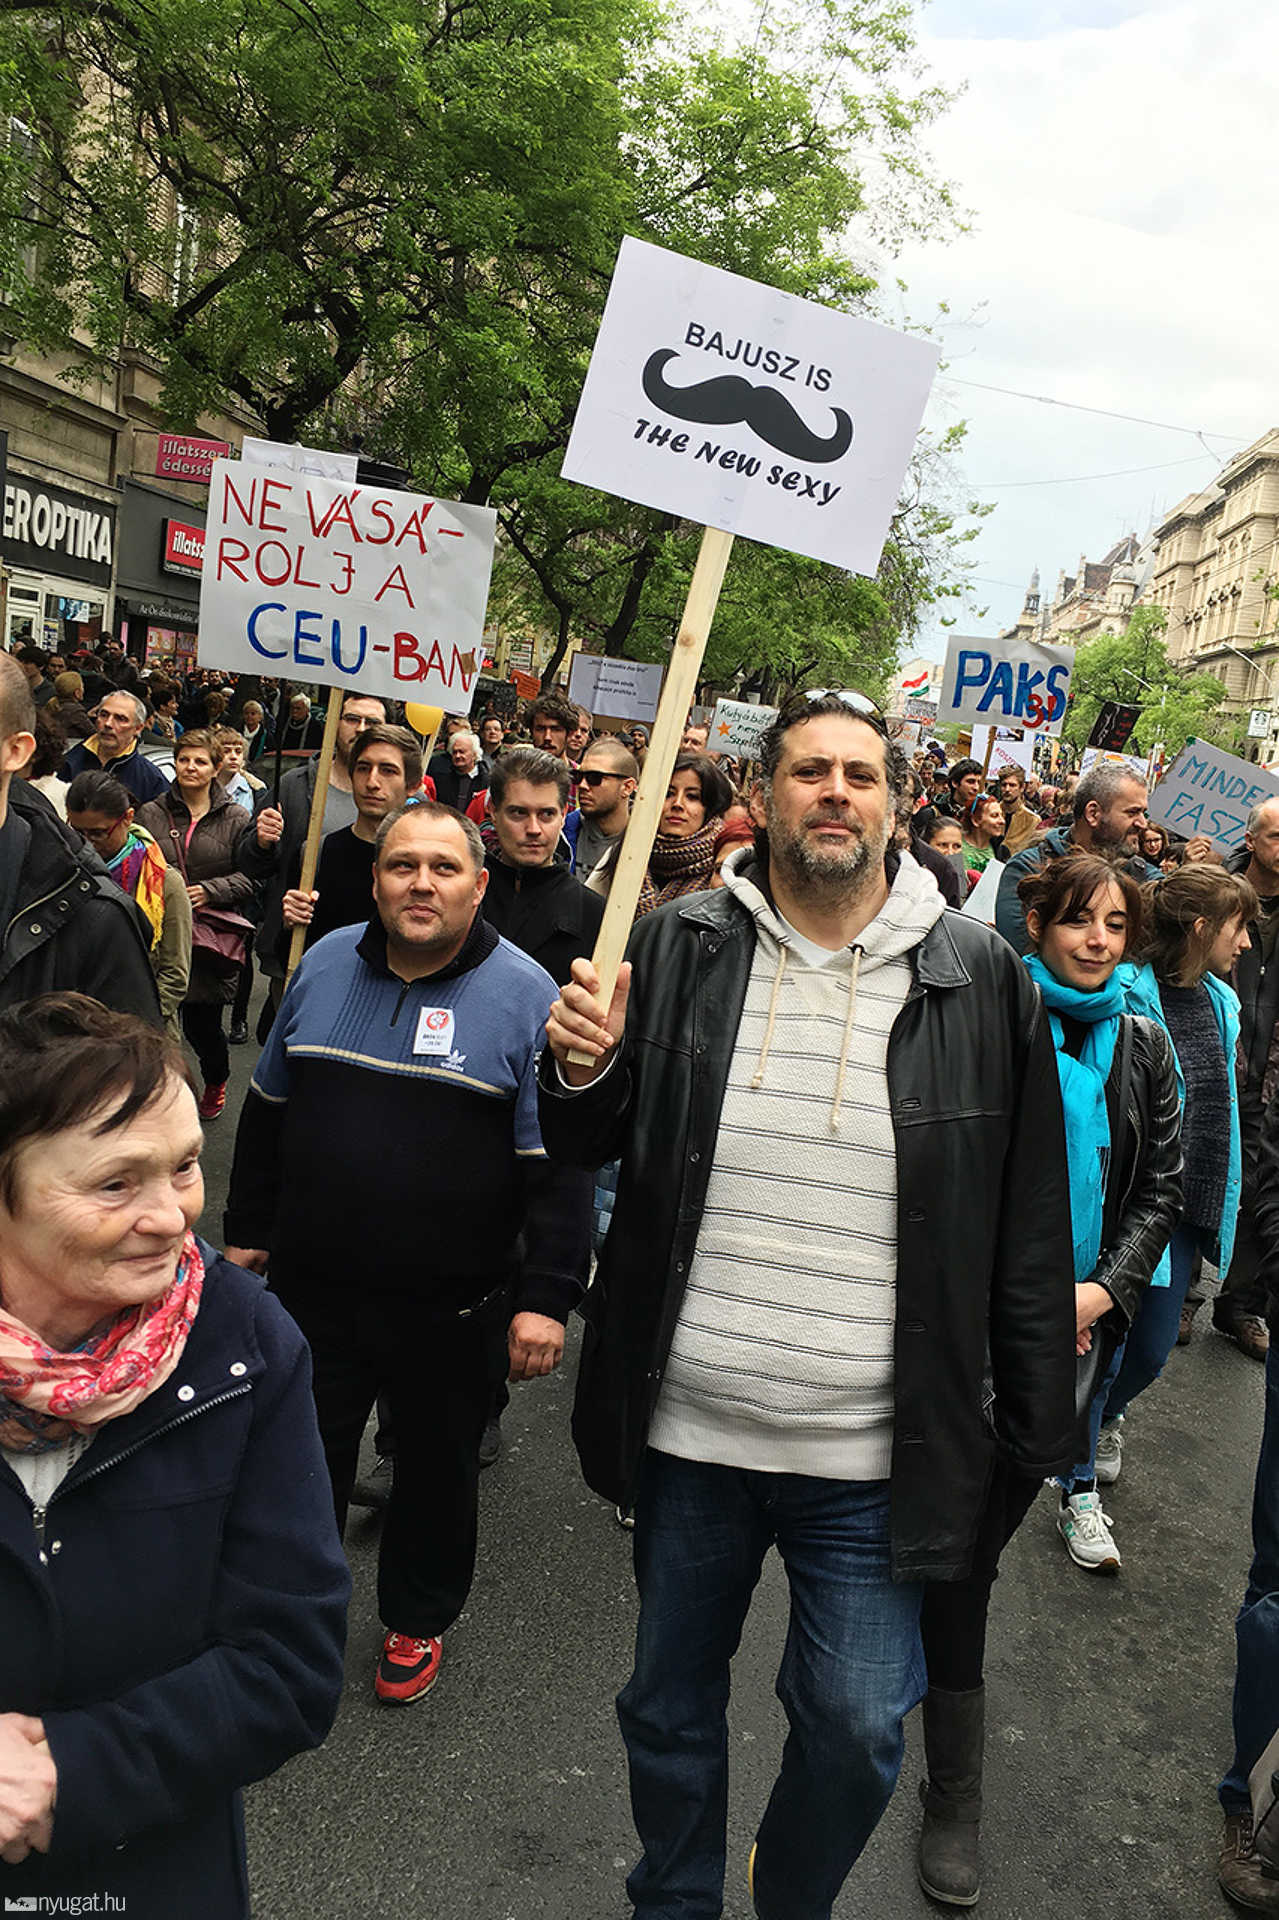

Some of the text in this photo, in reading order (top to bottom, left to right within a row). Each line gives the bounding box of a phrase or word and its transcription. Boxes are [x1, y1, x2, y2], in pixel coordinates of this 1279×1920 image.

[684, 321, 833, 392] BAJUSZ IS
[633, 418, 841, 506] THE NEW SEXY
[3, 485, 112, 565] EROPTIKA
[222, 473, 465, 555] NE VÁSÁ-
[216, 537, 416, 610] ROLJ A
[247, 602, 476, 694] CEU-BAN
[951, 650, 1070, 722] PAKS
[1022, 693, 1058, 733] 3!
[1178, 755, 1275, 809] MINDE
